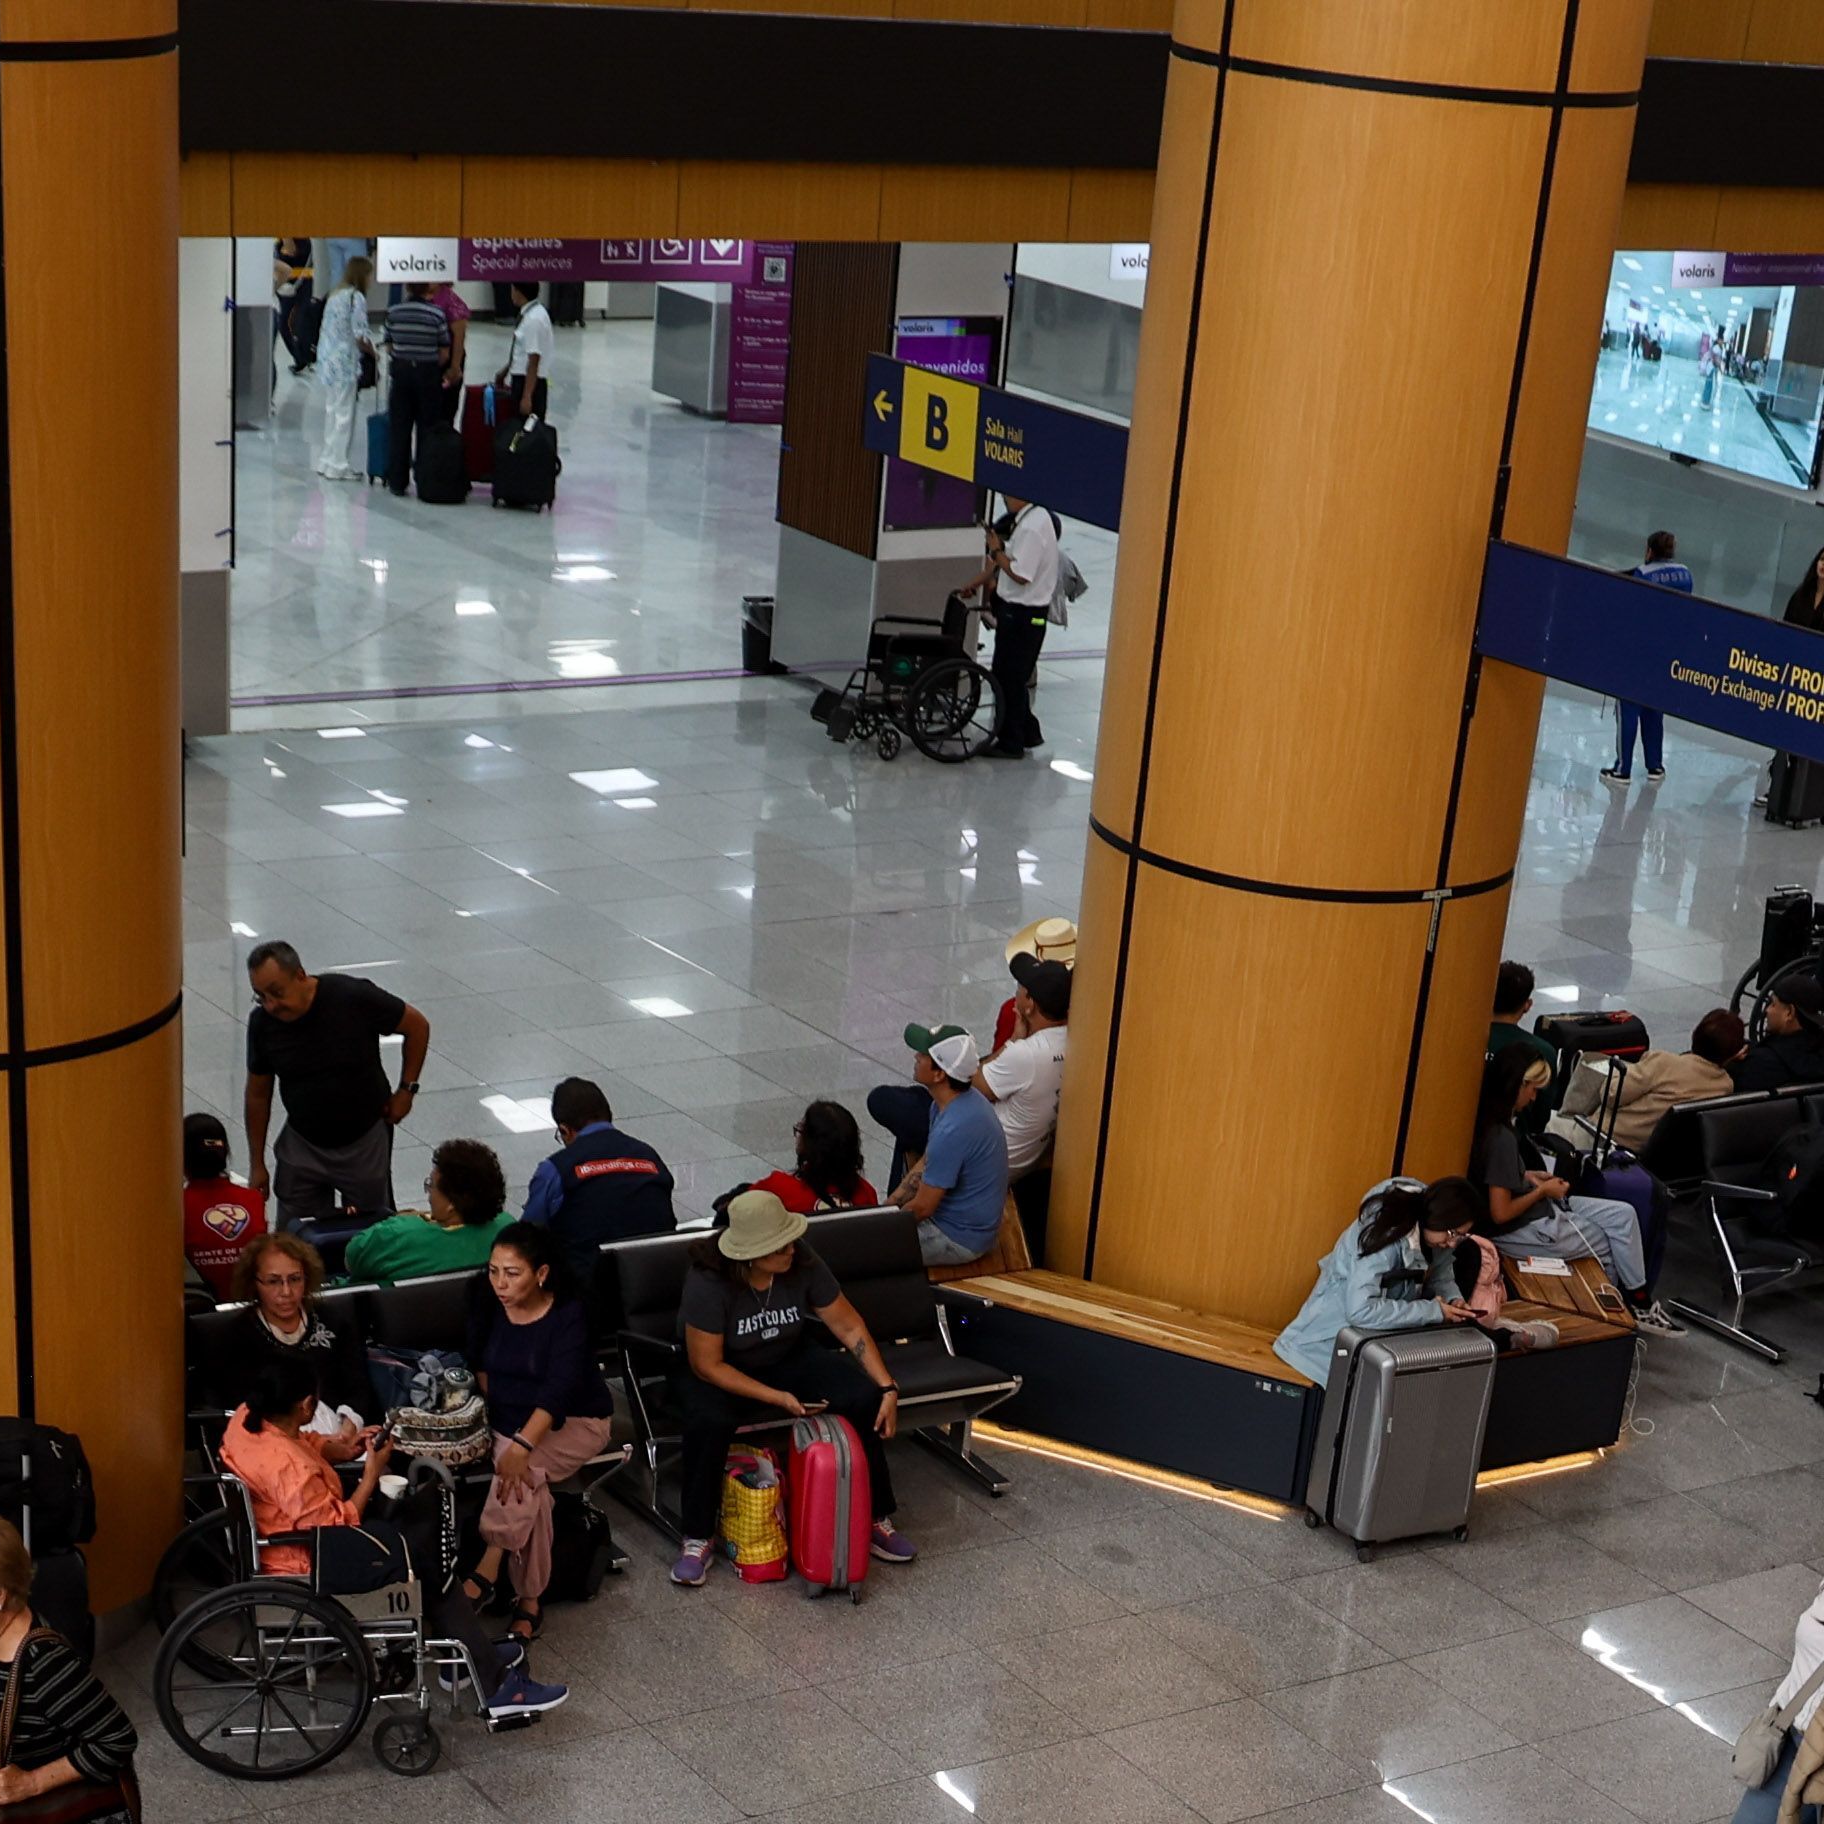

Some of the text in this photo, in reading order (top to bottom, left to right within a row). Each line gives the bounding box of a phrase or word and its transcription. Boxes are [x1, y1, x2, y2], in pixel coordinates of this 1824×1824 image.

[389, 254, 446, 271] volaris
[472, 253, 572, 273] Special services
[1680, 263, 1715, 279] volaris
[926, 392, 949, 451] B
[985, 416, 1024, 444] Sala Hall
[984, 439, 1024, 469] VOLARIS
[1728, 647, 1780, 682] Divisas
[1780, 662, 1790, 684] /
[1670, 659, 1719, 696] Currency
[1721, 675, 1776, 711] Exchange
[1776, 689, 1785, 711] /
[737, 1312, 764, 1335] EAST
[765, 1306, 800, 1326] COAST
[388, 1591, 410, 1614] 10
